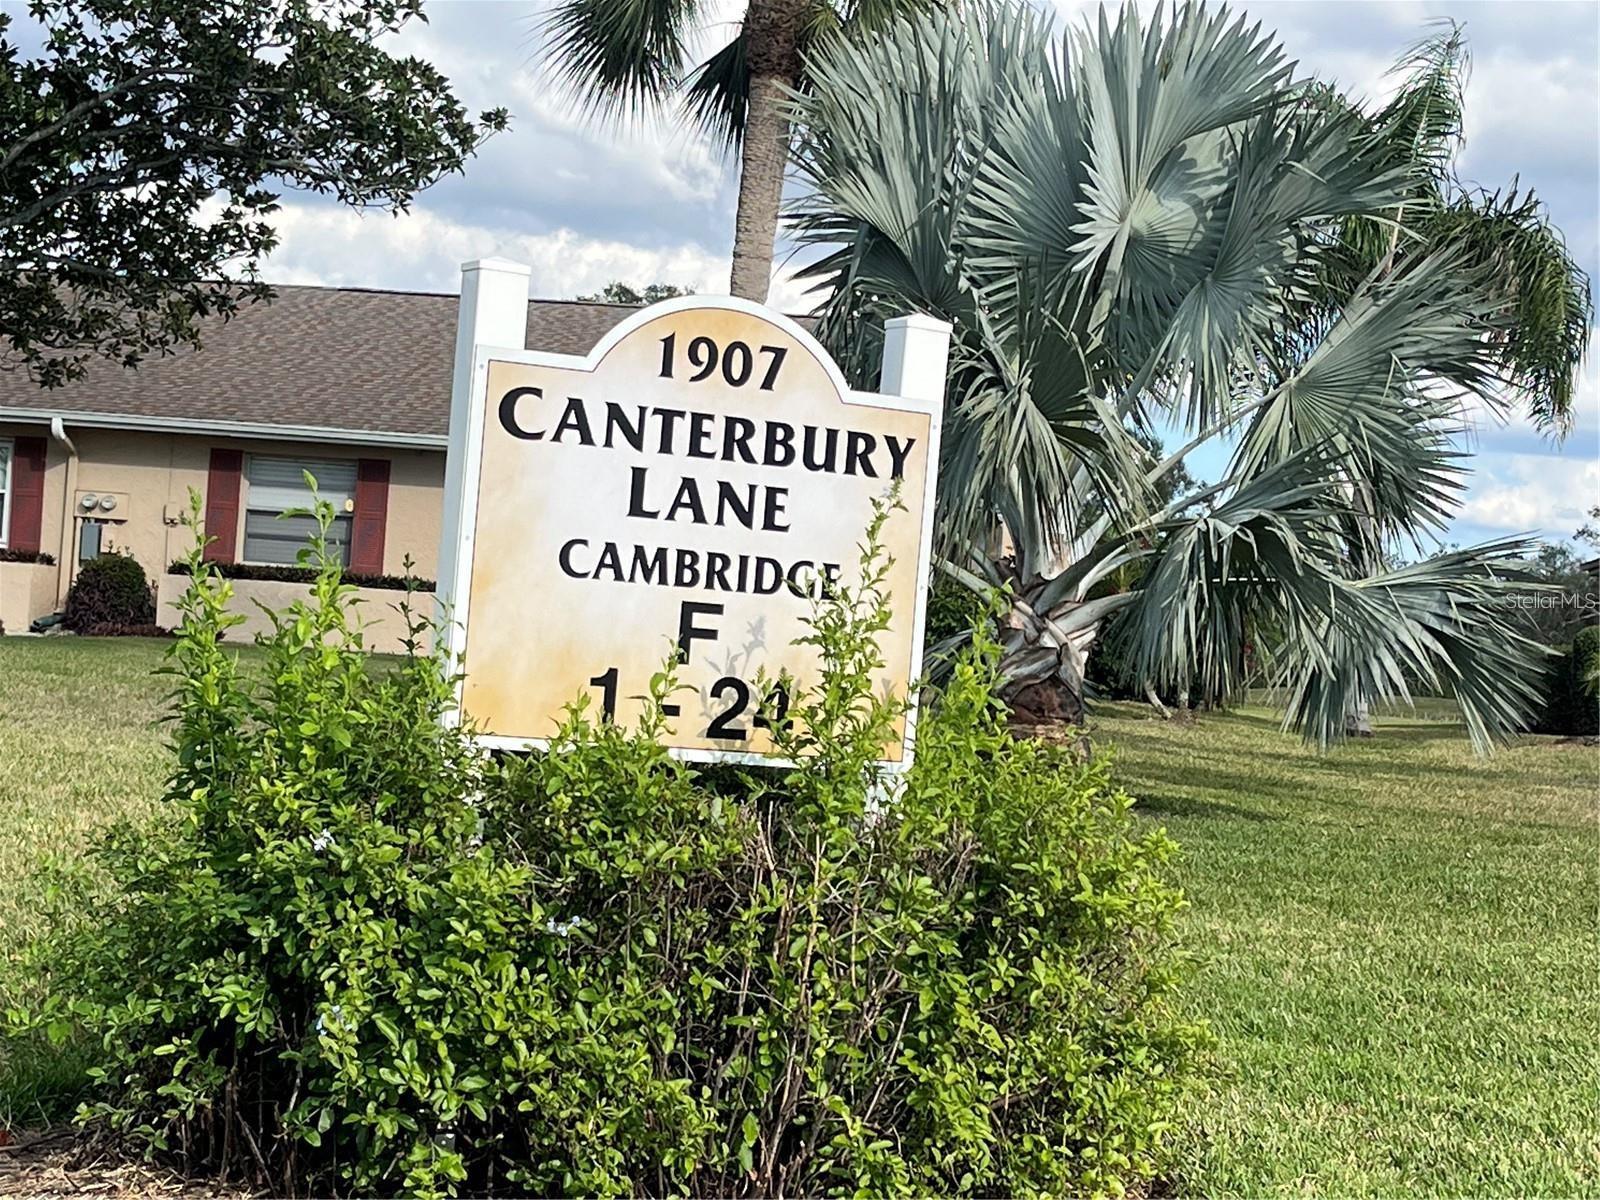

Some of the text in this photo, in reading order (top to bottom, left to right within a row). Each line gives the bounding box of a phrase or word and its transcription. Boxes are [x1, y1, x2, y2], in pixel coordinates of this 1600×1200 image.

[656, 332, 788, 391] 1907
[498, 386, 916, 480] CANTERBURY
[626, 466, 791, 532] LANE
[558, 538, 842, 600] CAMBRIDGE
[677, 600, 725, 665] F
[589, 667, 619, 726] 1
